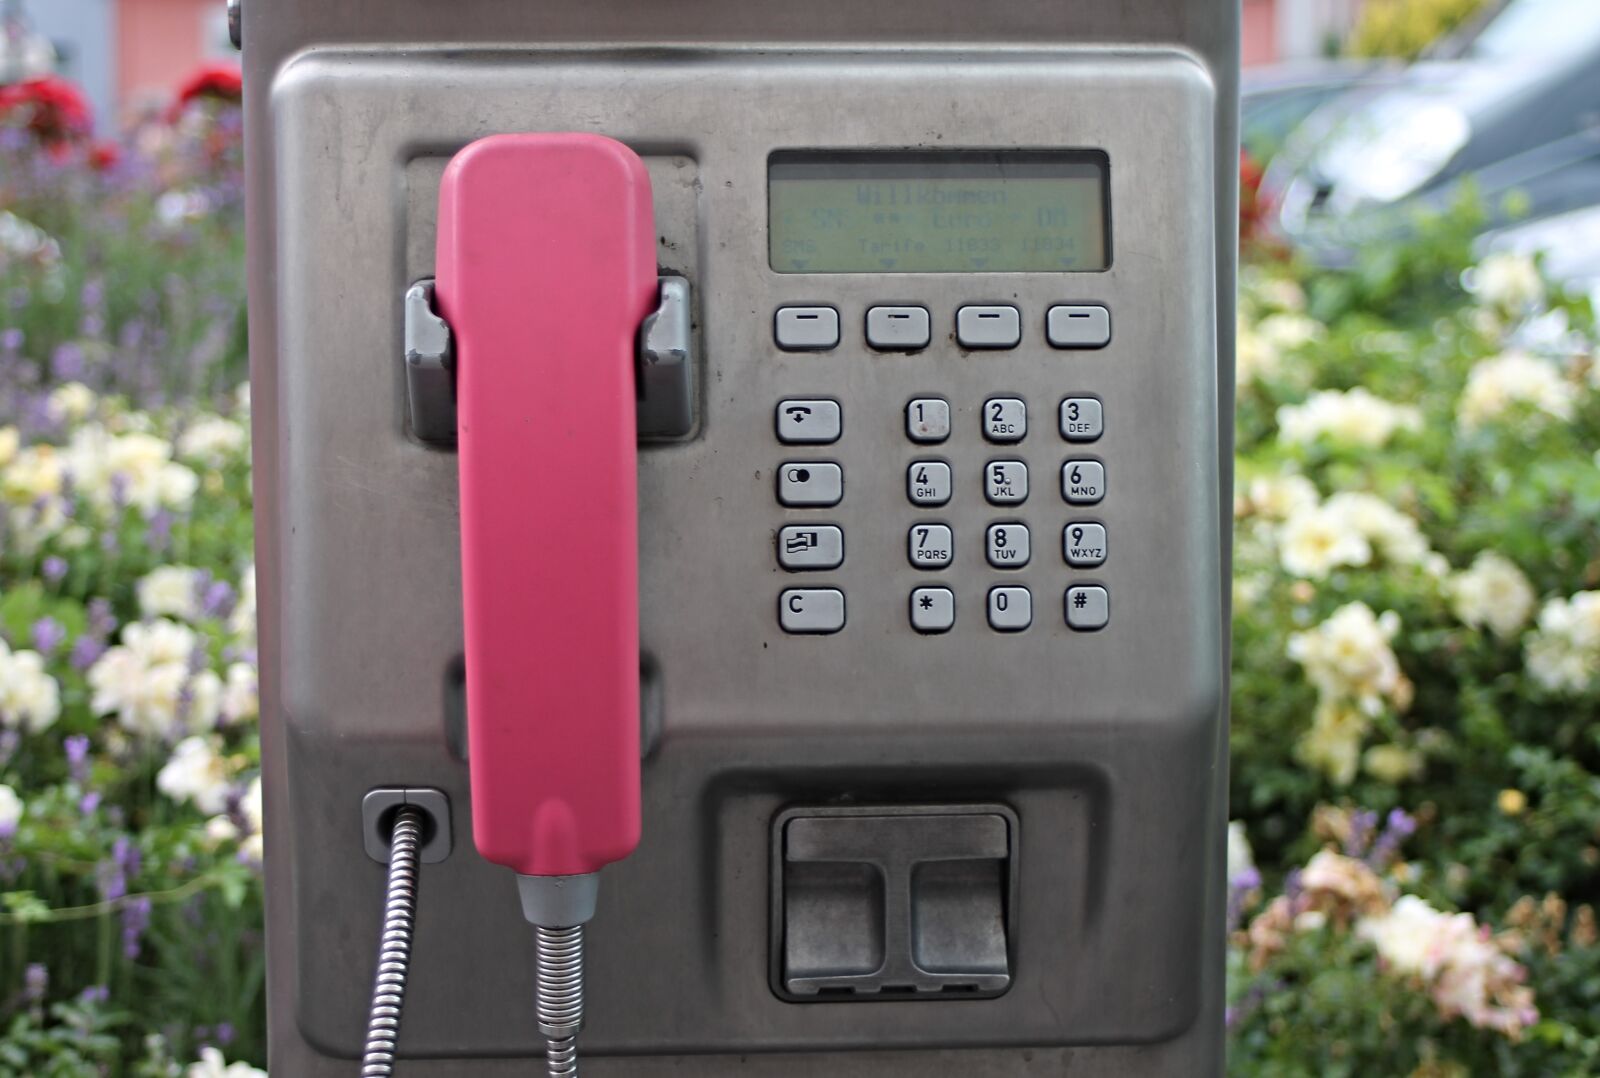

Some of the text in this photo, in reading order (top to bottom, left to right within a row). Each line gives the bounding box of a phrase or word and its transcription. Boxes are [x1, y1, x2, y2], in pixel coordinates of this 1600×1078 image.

[916, 404, 924, 422] 1
[992, 404, 1003, 422] 2
[1068, 403, 1079, 421] 3
[992, 424, 1015, 434] ABC
[1069, 424, 1090, 433] DEF
[916, 467, 928, 485] 4
[993, 466, 1004, 485] 5
[1071, 466, 1082, 484] 6
[916, 488, 936, 498] GHI
[993, 487, 1015, 497] JKL
[1071, 487, 1097, 496] MNO
[917, 529, 928, 547] 7
[995, 529, 1007, 547] 8
[1072, 528, 1083, 546] 9
[917, 550, 948, 560] PQRS
[994, 550, 1017, 560] TUV
[1070, 549, 1102, 559] WXYZ
[789, 595, 803, 613] C
[997, 593, 1007, 611] 0
[1073, 592, 1087, 609] #
